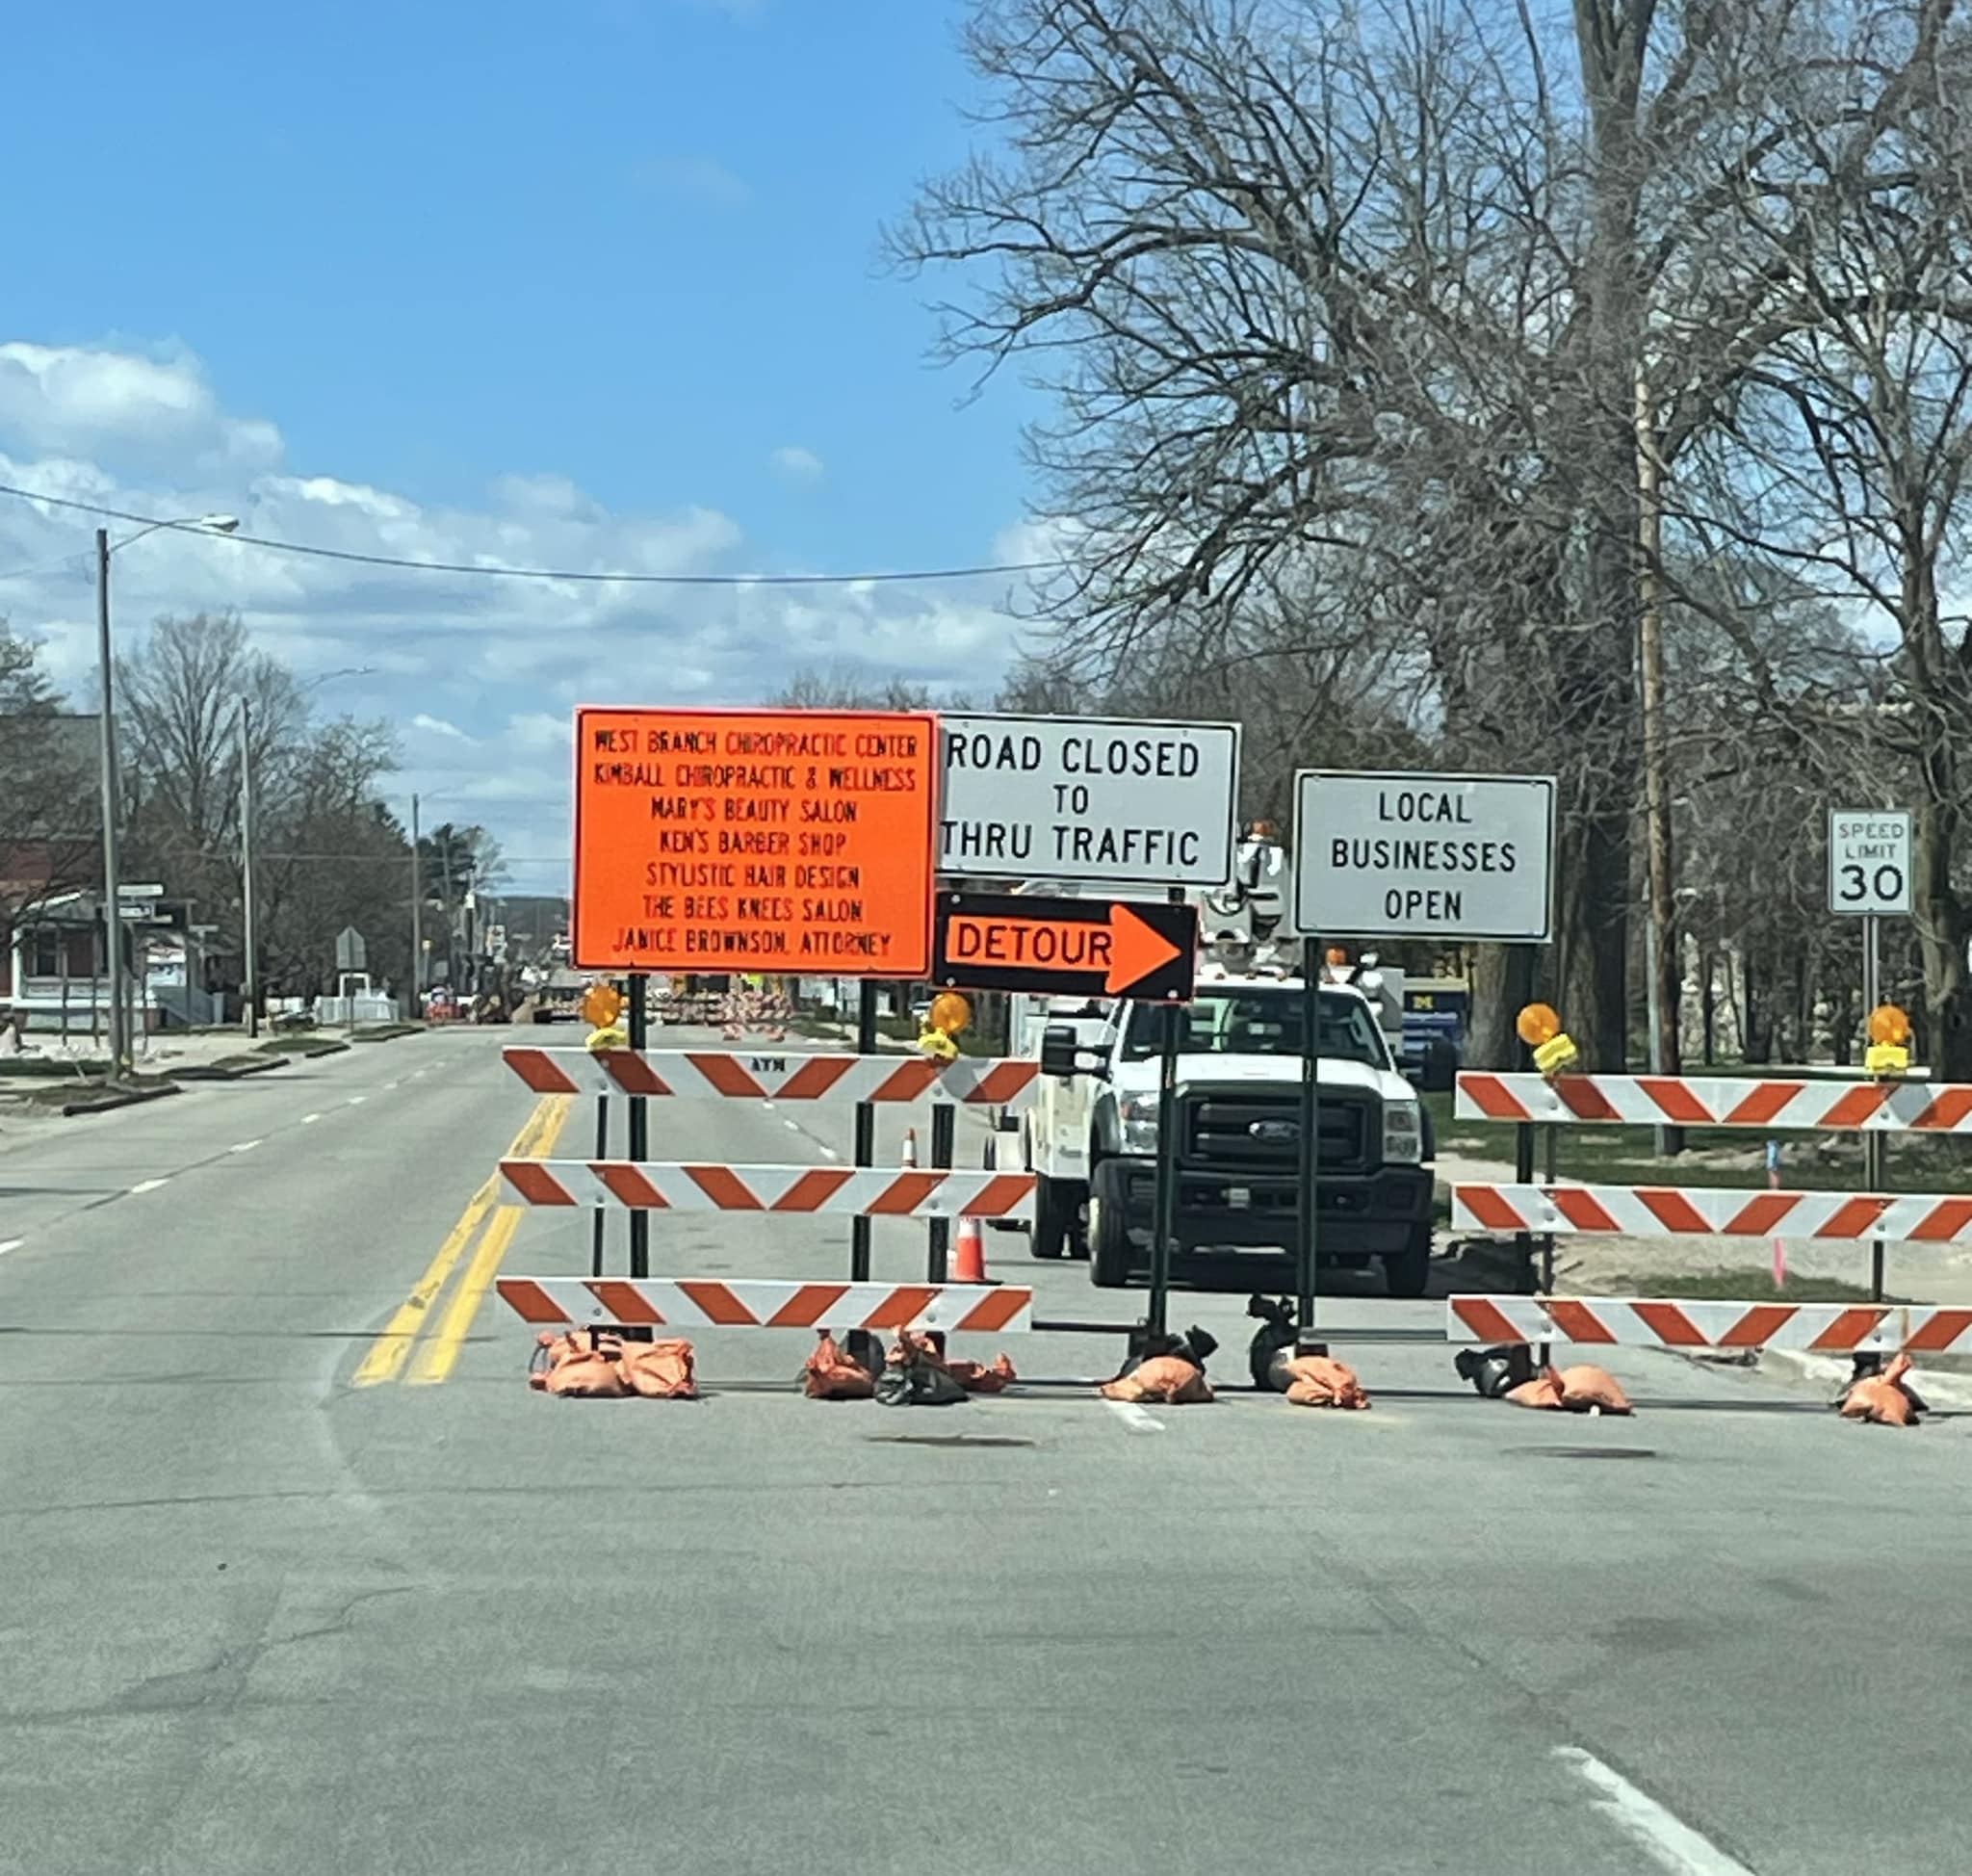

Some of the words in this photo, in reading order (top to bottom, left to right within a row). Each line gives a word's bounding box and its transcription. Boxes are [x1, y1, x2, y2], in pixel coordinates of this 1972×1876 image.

[594, 729, 638, 753] WEST
[647, 730, 717, 754] BRANCH
[725, 731, 847, 758] CHIROPRACTIC
[855, 733, 918, 758] CENTER
[946, 733, 1042, 770] ROAD
[1062, 738, 1200, 777] CLOSED
[593, 763, 666, 787] KIMBALL
[676, 764, 796, 791] CHIROPRACTIC
[805, 767, 817, 790] &
[828, 767, 916, 792] WELLNESS
[651, 795, 716, 821] MARY'S
[724, 796, 790, 822] BEAUTY
[800, 798, 857, 823] SALON
[1052, 784, 1089, 815] TO
[1379, 792, 1472, 823] LOCAL
[661, 828, 710, 854] KEN'S
[718, 831, 790, 855] BARBER
[798, 831, 846, 856] SHOP
[940, 821, 1032, 859] THRU
[1052, 825, 1200, 867] TRAFFIC
[1839, 822, 1905, 839] SPEED
[1332, 839, 1517, 873] BUSINESSES
[1845, 844, 1896, 859] LIMIT
[646, 862, 736, 887] STYLISTIC
[744, 863, 786, 888] HAIR
[794, 865, 860, 889] DESIGN
[1839, 864, 1903, 901] 30
[643, 895, 675, 919] THE
[685, 895, 729, 921] BEES
[738, 897, 794, 922] KNEES
[801, 898, 864, 922] SALON
[1385, 889, 1463, 920] OPEN
[612, 927, 677, 952] JANICE
[799, 930, 892, 956] ATTORNEY
[957, 923, 1112, 966] DETOUR
